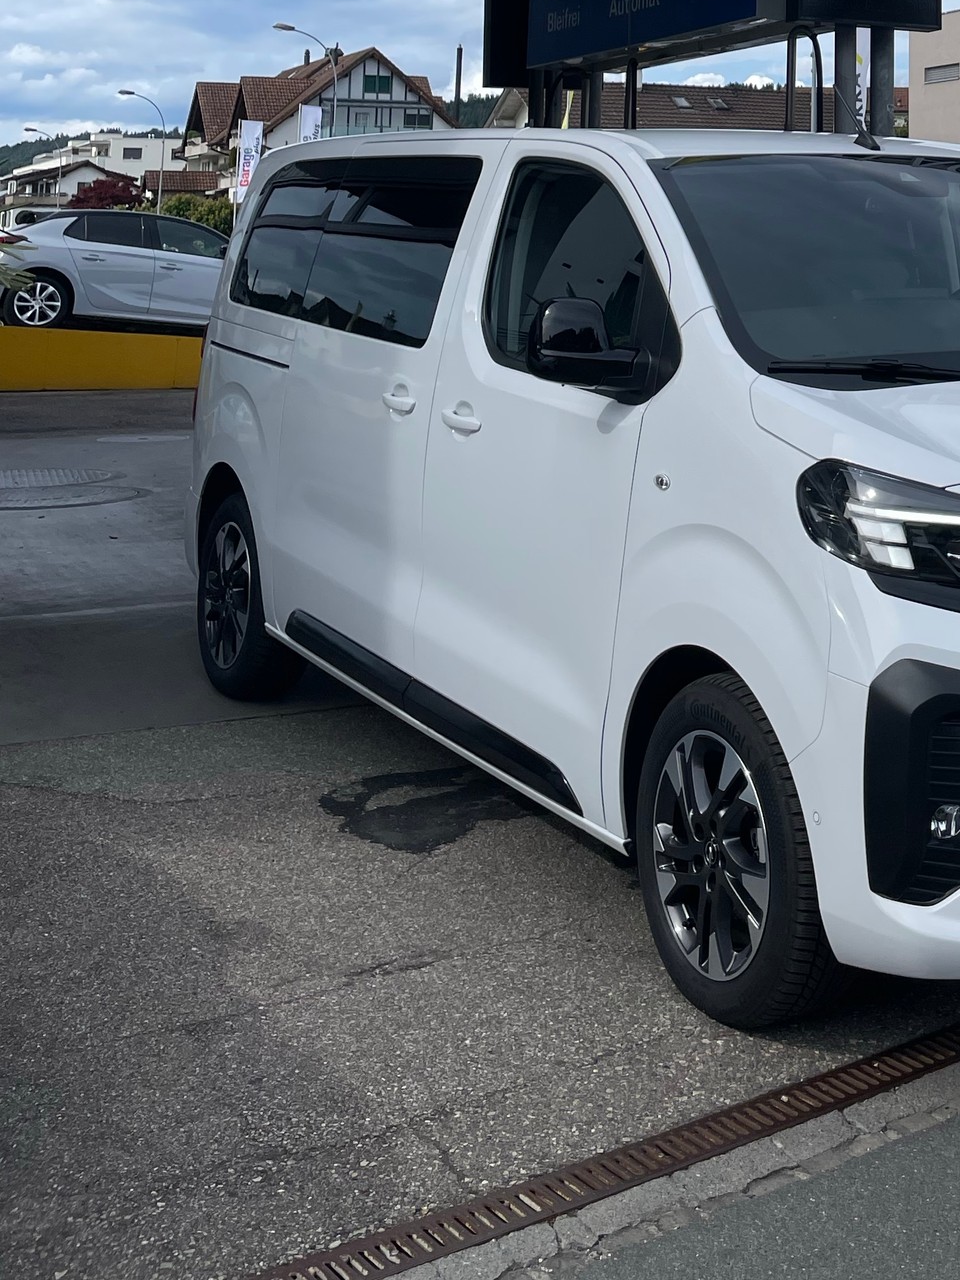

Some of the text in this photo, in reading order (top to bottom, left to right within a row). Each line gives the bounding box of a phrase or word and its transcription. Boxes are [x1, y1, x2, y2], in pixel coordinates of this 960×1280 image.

[547, 5, 581, 33] Bleifrei
[240, 147, 254, 187] Garage
[690, 699, 746, 750] Continental
